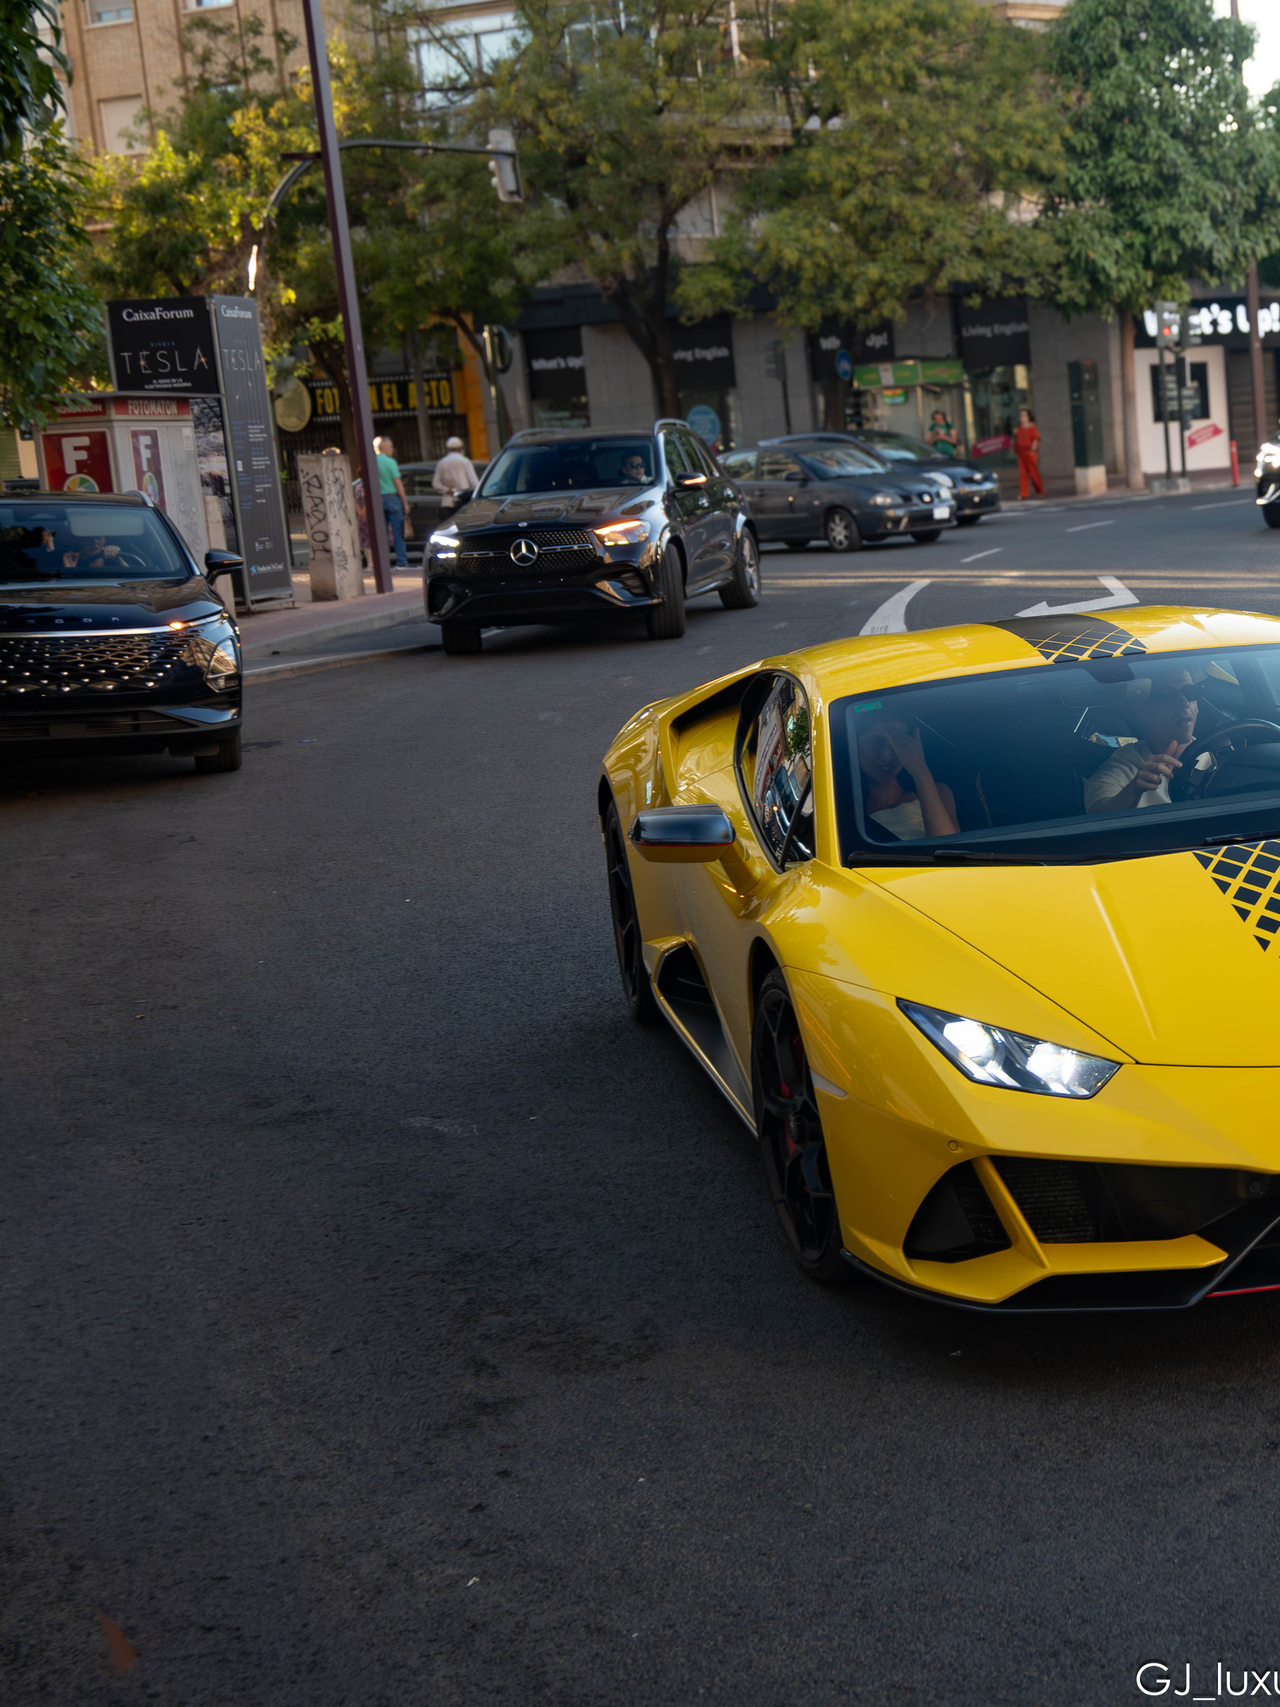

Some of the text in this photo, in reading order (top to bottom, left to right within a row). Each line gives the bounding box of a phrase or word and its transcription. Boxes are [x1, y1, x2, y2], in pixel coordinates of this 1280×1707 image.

[122, 307, 194, 322] CaixaForum
[221, 304, 253, 319] CaixaForum
[120, 346, 209, 374] TESLA
[222, 348, 262, 371] TESLA
[127, 399, 178, 415] FOTOMATON
[381, 383, 402, 410] EL
[61, 436, 90, 474] F
[138, 435, 152, 472] F
